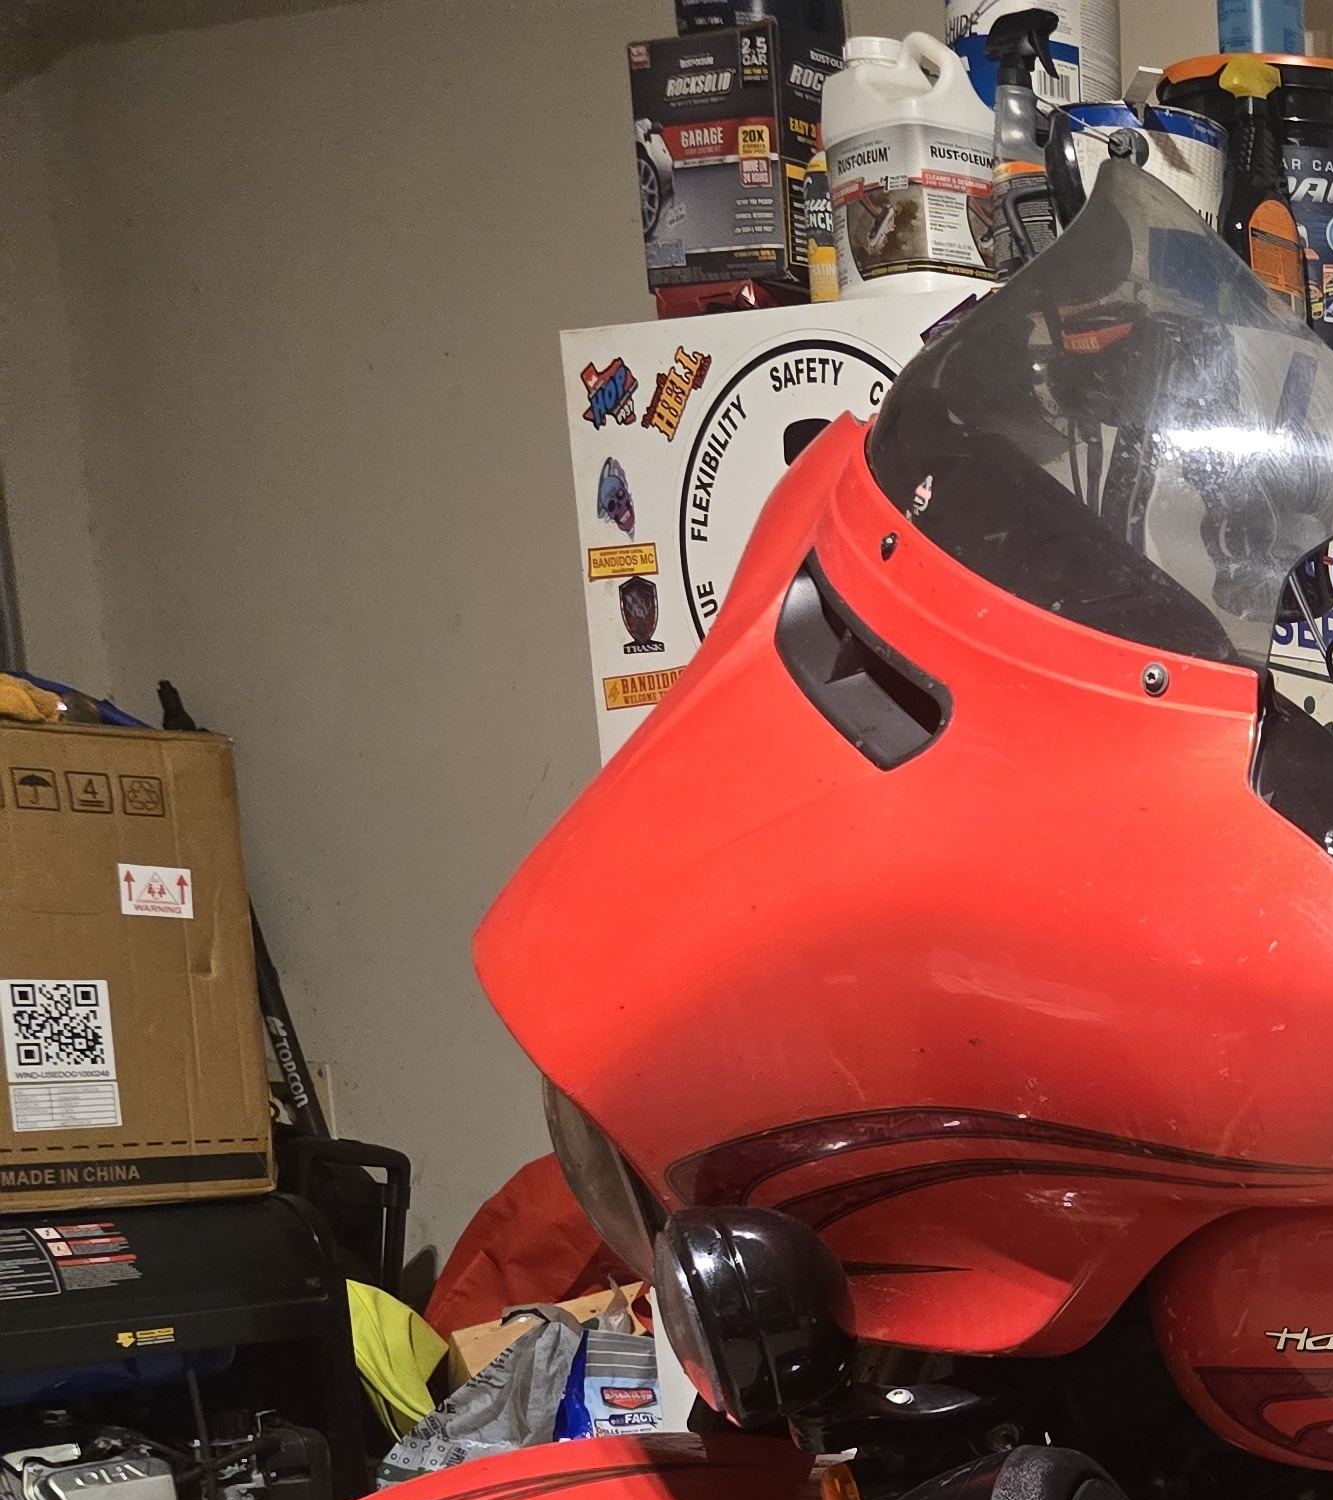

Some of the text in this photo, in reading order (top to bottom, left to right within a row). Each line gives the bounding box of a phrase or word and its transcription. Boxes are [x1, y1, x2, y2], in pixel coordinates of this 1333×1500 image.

[666, 71, 732, 97] ROCKSOLID
[680, 126, 724, 148] GARAGE
[742, 129, 765, 142] 20X
[837, 146, 888, 176] RUST-OLEUM
[689, 358, 844, 542] FLEXIBILITY SAFETY
[592, 553, 655, 569] BANDIDOS MC
[623, 692, 657, 705] WELCOME
[134, 903, 183, 915] WARNING
[1, 1164, 141, 1187] MADE IN CHINA
[74, 1462, 148, 1487] OHV
